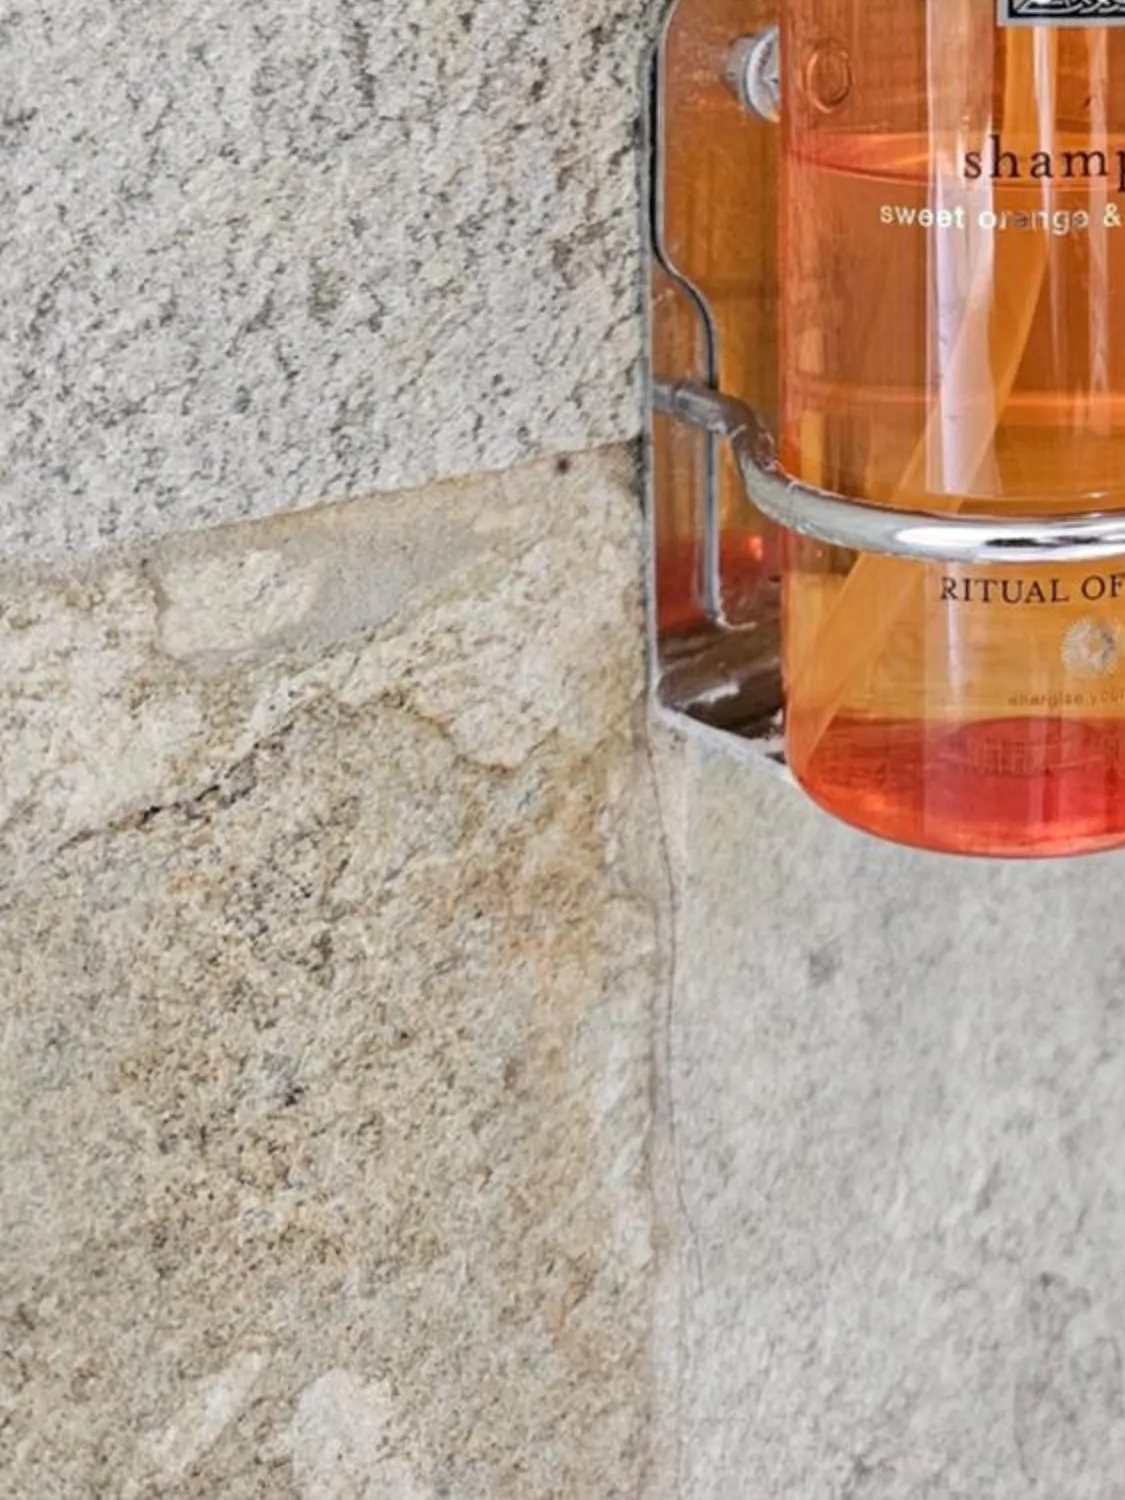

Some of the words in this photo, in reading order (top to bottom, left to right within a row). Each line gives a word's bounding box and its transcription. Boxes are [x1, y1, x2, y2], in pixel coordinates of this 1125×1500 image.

[879, 204, 965, 230] sweet
[977, 208, 1090, 236] orange
[1103, 202, 1121, 227] &
[939, 576, 1069, 604] RITUAL
